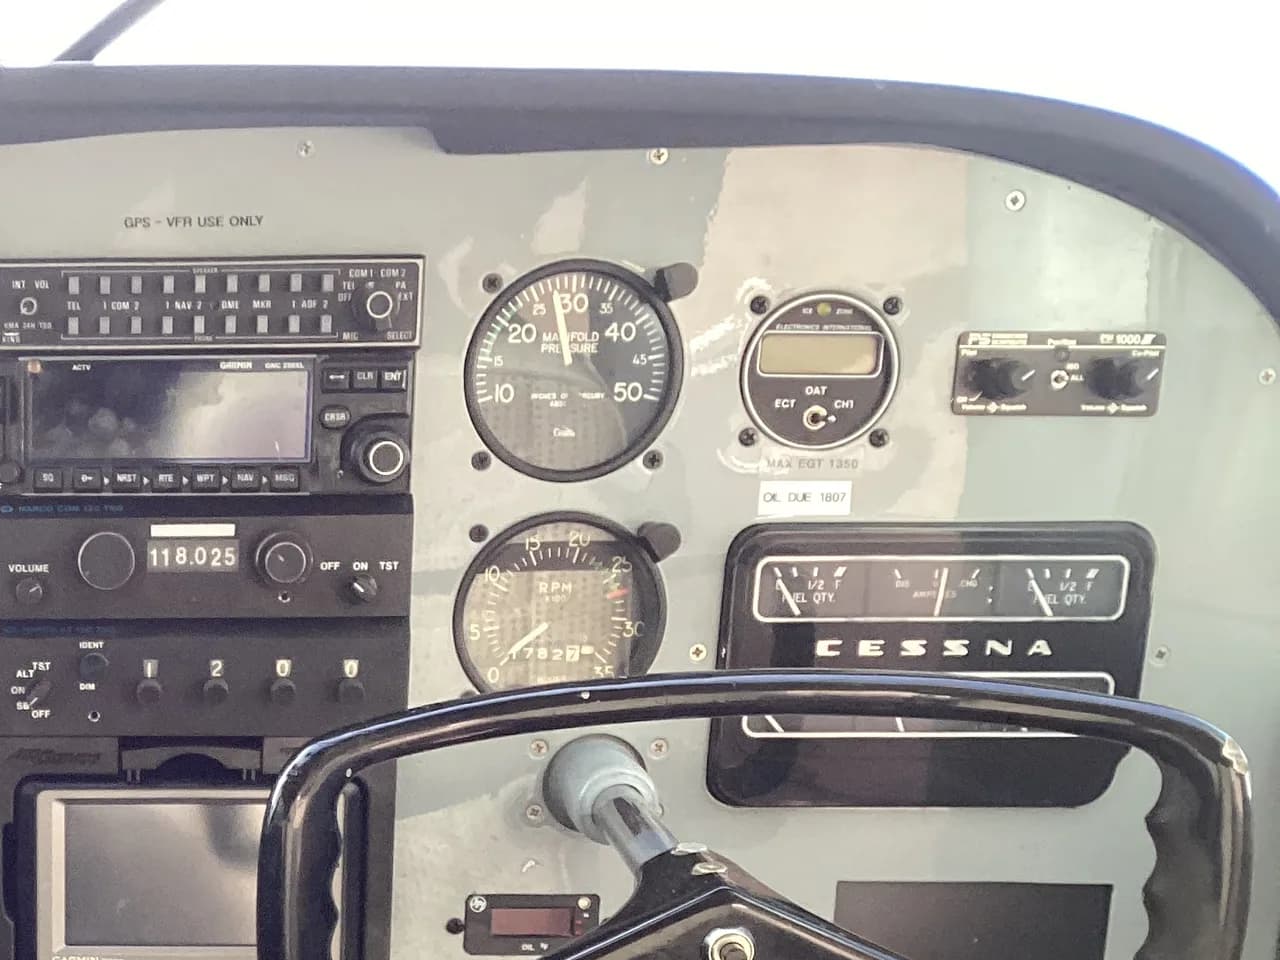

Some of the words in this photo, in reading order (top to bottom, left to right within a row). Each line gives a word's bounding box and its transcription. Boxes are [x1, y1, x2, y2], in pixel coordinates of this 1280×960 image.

[124, 216, 151, 228] GPS
[167, 216, 192, 227] VFR
[197, 215, 224, 227] USE
[229, 215, 264, 227] ONLY
[349, 269, 367, 278] COM
[380, 269, 399, 278] COM
[12, 280, 26, 289] INT
[34, 280, 49, 289] VOL
[343, 281, 355, 290] TEL
[396, 281, 406, 290] PA
[112, 302, 130, 311] COM
[175, 302, 192, 311] NAV
[560, 293, 588, 313] 30
[532, 304, 546, 316] 25
[600, 303, 613, 315] 35
[387, 332, 412, 340] SELECT
[508, 323, 537, 344] 20
[605, 322, 636, 342] 40
[493, 355, 503, 367] 15
[632, 354, 647, 365] 45
[357, 372, 373, 381] CLR
[385, 371, 401, 381] ENT
[495, 384, 514, 404] 10
[613, 382, 642, 402] 50
[805, 386, 827, 396] OAT
[767, 459, 792, 469] MAX
[830, 459, 859, 469] 1350
[117, 474, 137, 482] NRST
[159, 474, 174, 482] RTE
[196, 474, 214, 482] WPT
[237, 474, 254, 482] NAV
[788, 492, 812, 503] DUE
[821, 492, 847, 503] 1807
[525, 534, 541, 551] 15
[569, 532, 590, 547] 20
[149, 547, 236, 566] 118.025
[8, 564, 49, 573] VOLUME
[320, 561, 340, 570] OFF
[353, 561, 368, 571] ON
[379, 561, 399, 570] TST
[612, 556, 632, 573] 25
[485, 566, 501, 582] 10
[539, 582, 572, 594] RPM
[808, 580, 824, 590] 1/2
[1060, 582, 1077, 591] 1/2
[470, 624, 481, 640] 5
[623, 621, 645, 638] 30
[79, 641, 104, 649] IDENT
[816, 639, 1052, 657] CESSNA
[32, 662, 51, 671] TST
[210, 660, 222, 677] 2
[277, 660, 289, 677] 0
[344, 661, 358, 678] 0
[16, 670, 34, 678] ALT
[487, 667, 500, 682] 0
[11, 686, 26, 695] ON
[32, 710, 51, 719] OFF
